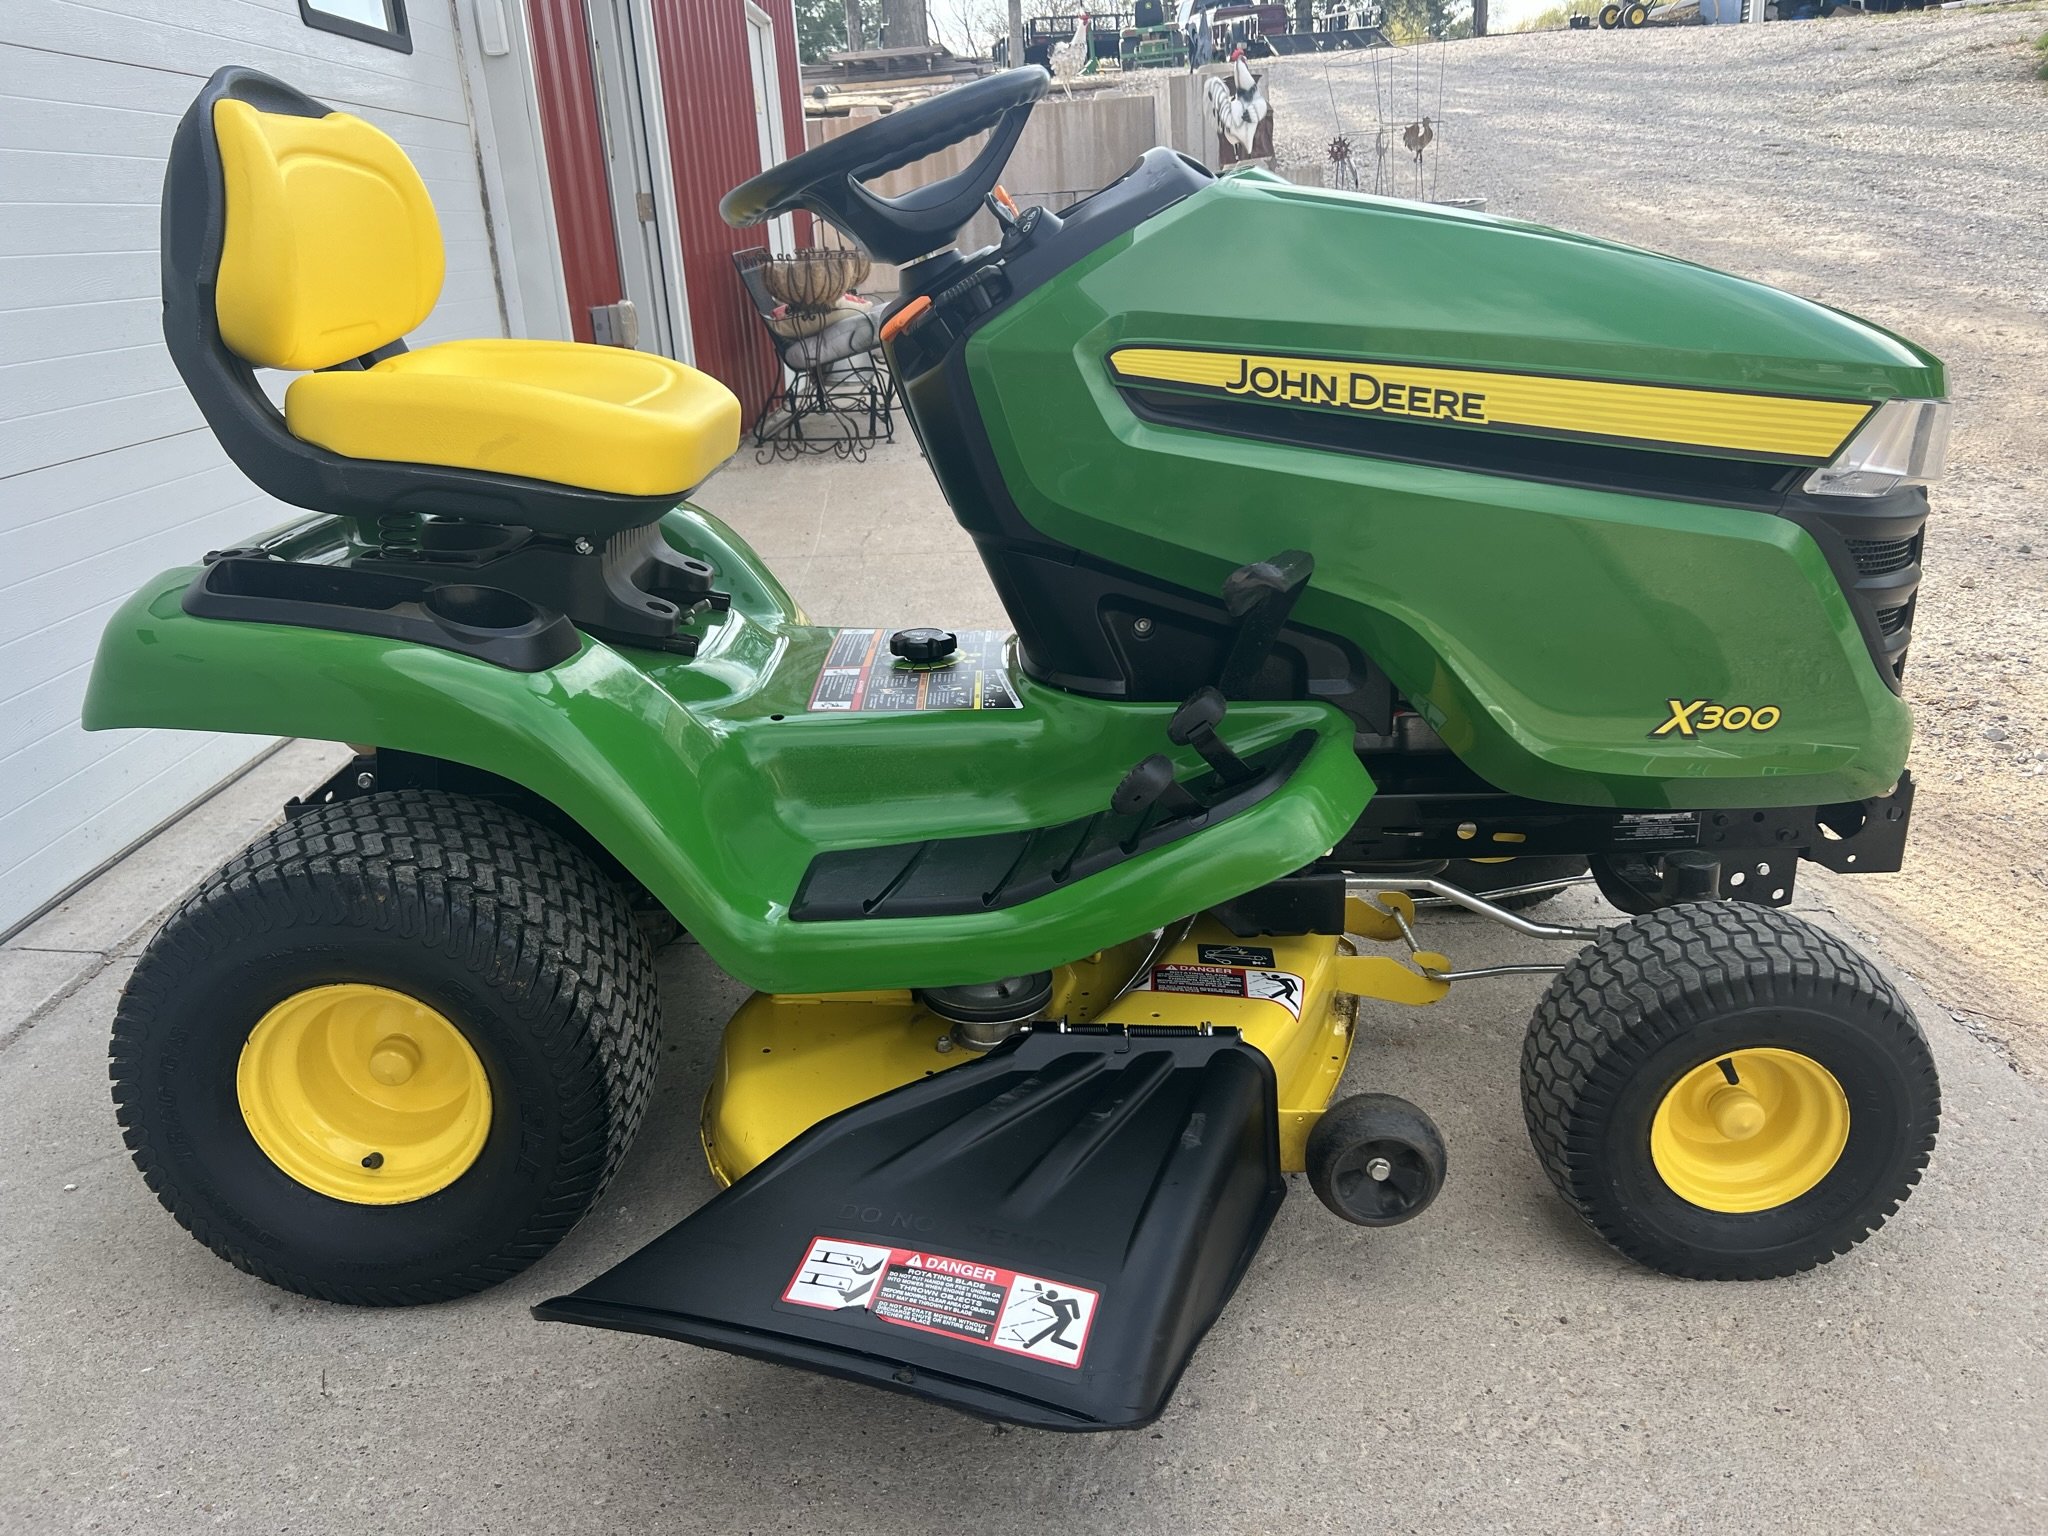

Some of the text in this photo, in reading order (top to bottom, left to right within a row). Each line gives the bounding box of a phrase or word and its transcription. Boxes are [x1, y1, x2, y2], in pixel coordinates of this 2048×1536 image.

[1226, 358, 1486, 421] JOHN DEERE
[1649, 698, 1781, 738] X300
[1180, 965, 1232, 974] DANGER
[908, 1268, 986, 1290] ROTATING BLADE
[925, 1257, 997, 1281] DANGER
[887, 1275, 901, 1283] INTO
[902, 1279, 924, 1288] MOWER
[925, 1283, 942, 1292] WHEN
[942, 1286, 964, 1296] ENGINE
[972, 1293, 999, 1304] RUNNING
[900, 1284, 982, 1307] THROWN OBJECTS
[924, 1277, 945, 1286] HANDS
[970, 1287, 991, 1296] UNDER
[880, 1291, 896, 1299] THAT
[918, 1299, 944, 1310] THROWN
[952, 1307, 973, 1317] BLADE
[882, 1287, 904, 1296] BEFORE
[928, 1296, 946, 1305] CLEAR
[946, 1300, 962, 1308] AREA
[970, 1306, 996, 1316] OBJECTS
[875, 1309, 903, 1319] CATCHER
[910, 1317, 931, 1326] PLACE
[903, 1306, 932, 1316] OPERATE
[933, 1312, 957, 1322] MOWER
[958, 1318, 988, 1329] WITHOUT
[912, 1312, 932, 1320] CHUTE
[942, 1320, 964, 1329] ENTIRE
[964, 1325, 986, 1335] GRASS
